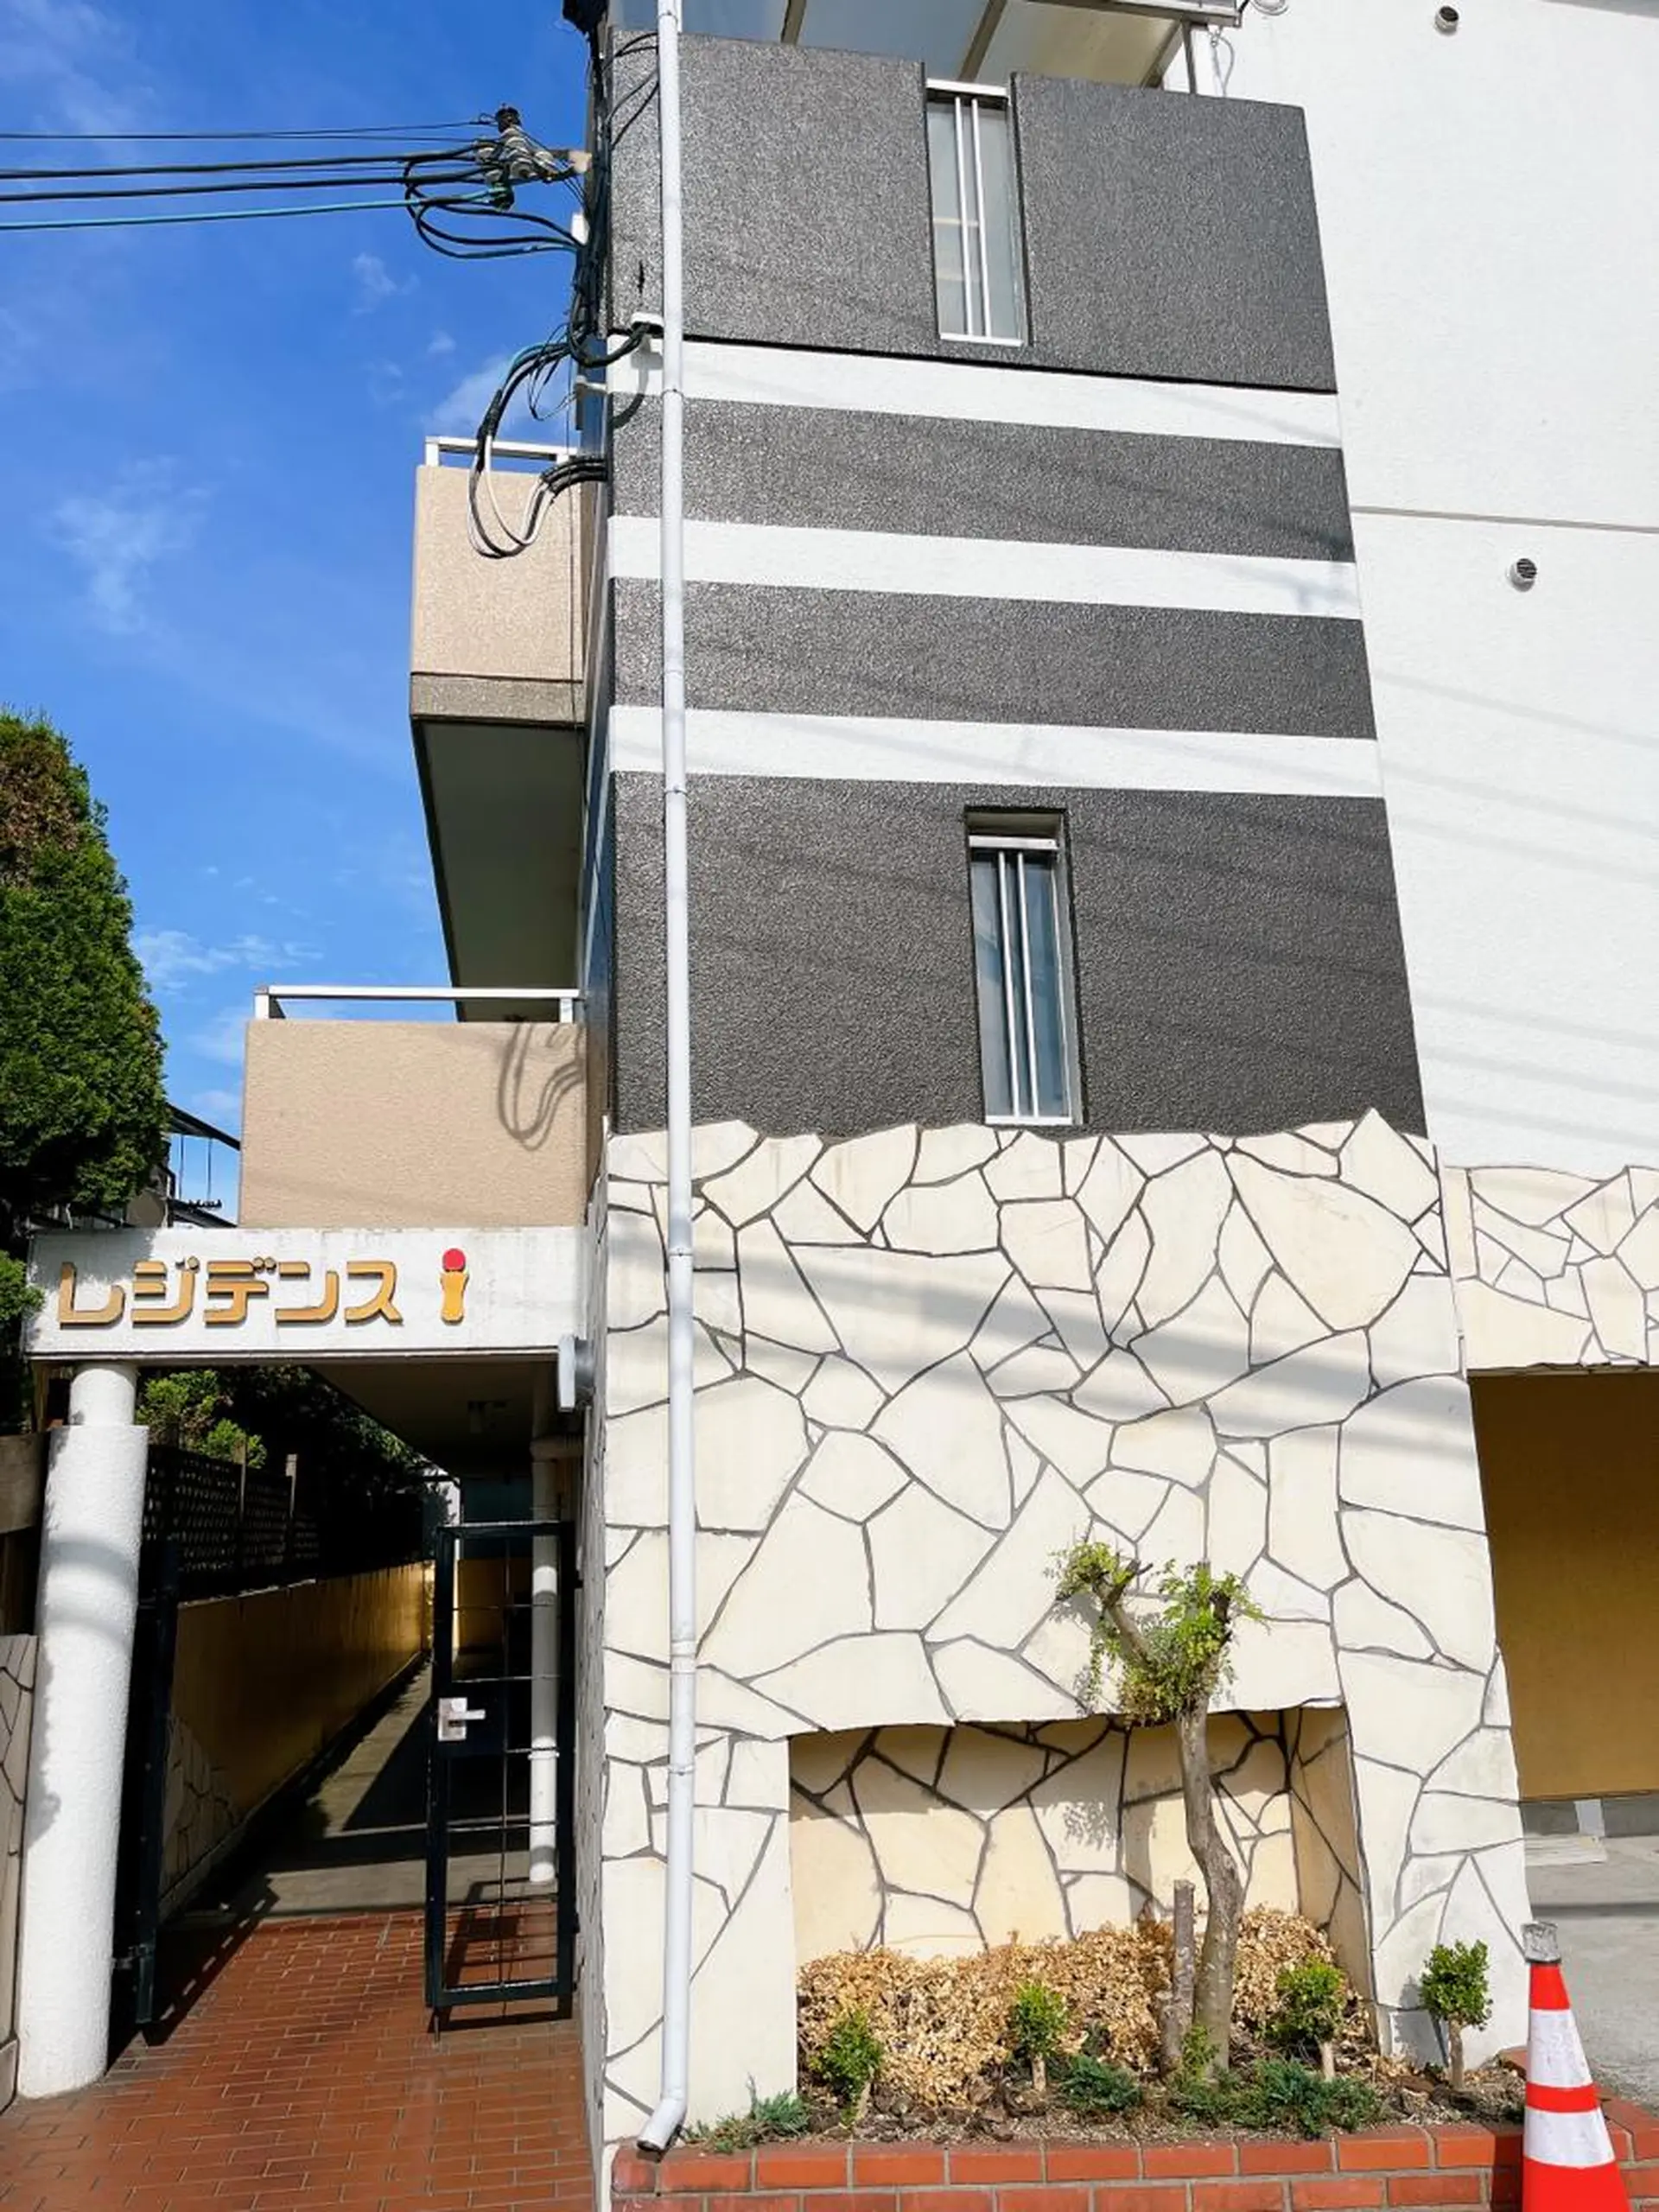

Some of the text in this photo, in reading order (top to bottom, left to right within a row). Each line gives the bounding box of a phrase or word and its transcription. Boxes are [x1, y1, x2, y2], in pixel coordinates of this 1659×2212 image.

[57, 1247, 470, 1328] レジデンス i
